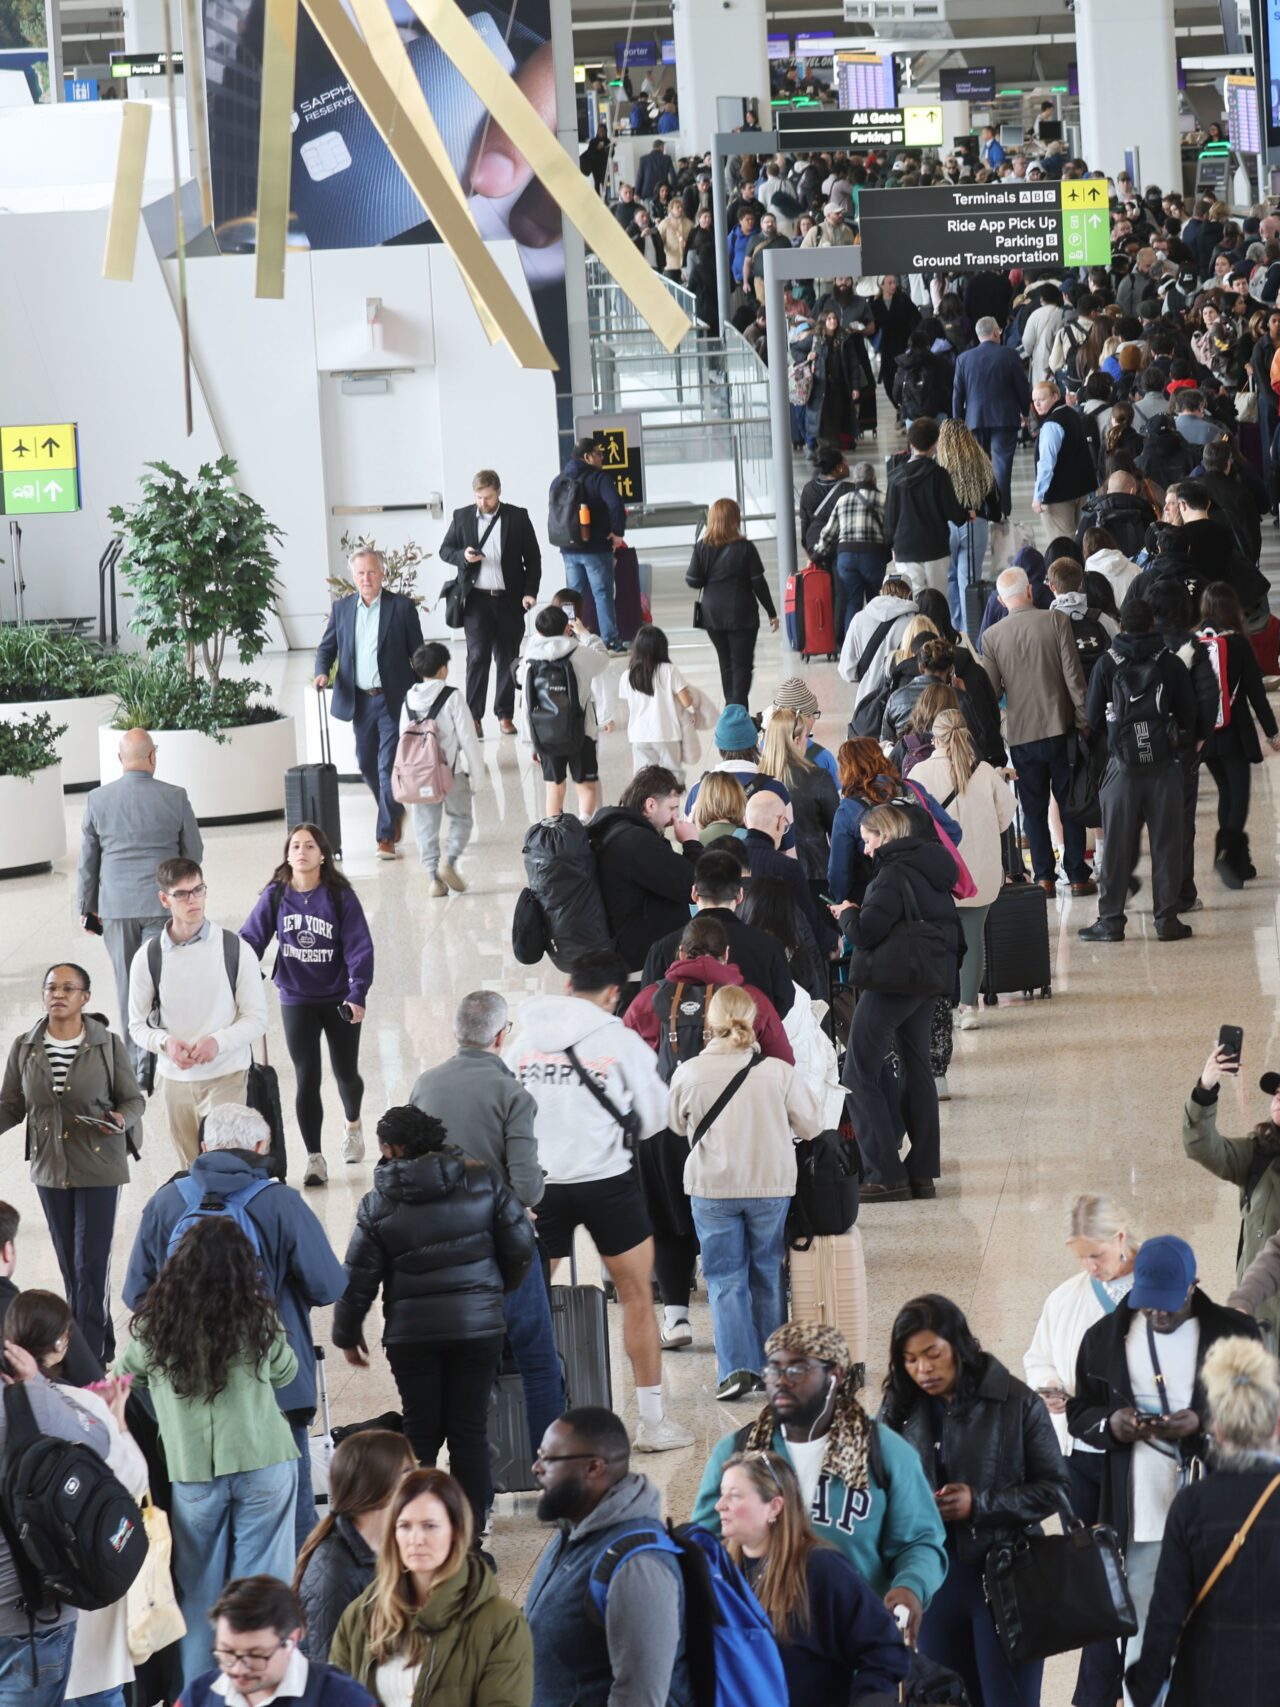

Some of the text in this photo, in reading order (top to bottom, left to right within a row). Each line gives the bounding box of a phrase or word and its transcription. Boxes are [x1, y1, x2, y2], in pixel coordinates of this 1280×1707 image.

[300, 83, 352, 113] SAPPH
[305, 94, 355, 123] RESERVE
[852, 112, 902, 125] All Gates
[850, 132, 891, 145] Parking
[953, 192, 1016, 205] Terminals
[948, 217, 1057, 233] Ride App Pick Up
[996, 234, 1044, 249] Parking
[913, 250, 1059, 267] Ground Transportation
[615, 475, 633, 496] it
[305, 914, 333, 939] YORK
[811, 1473, 872, 1535] AP
